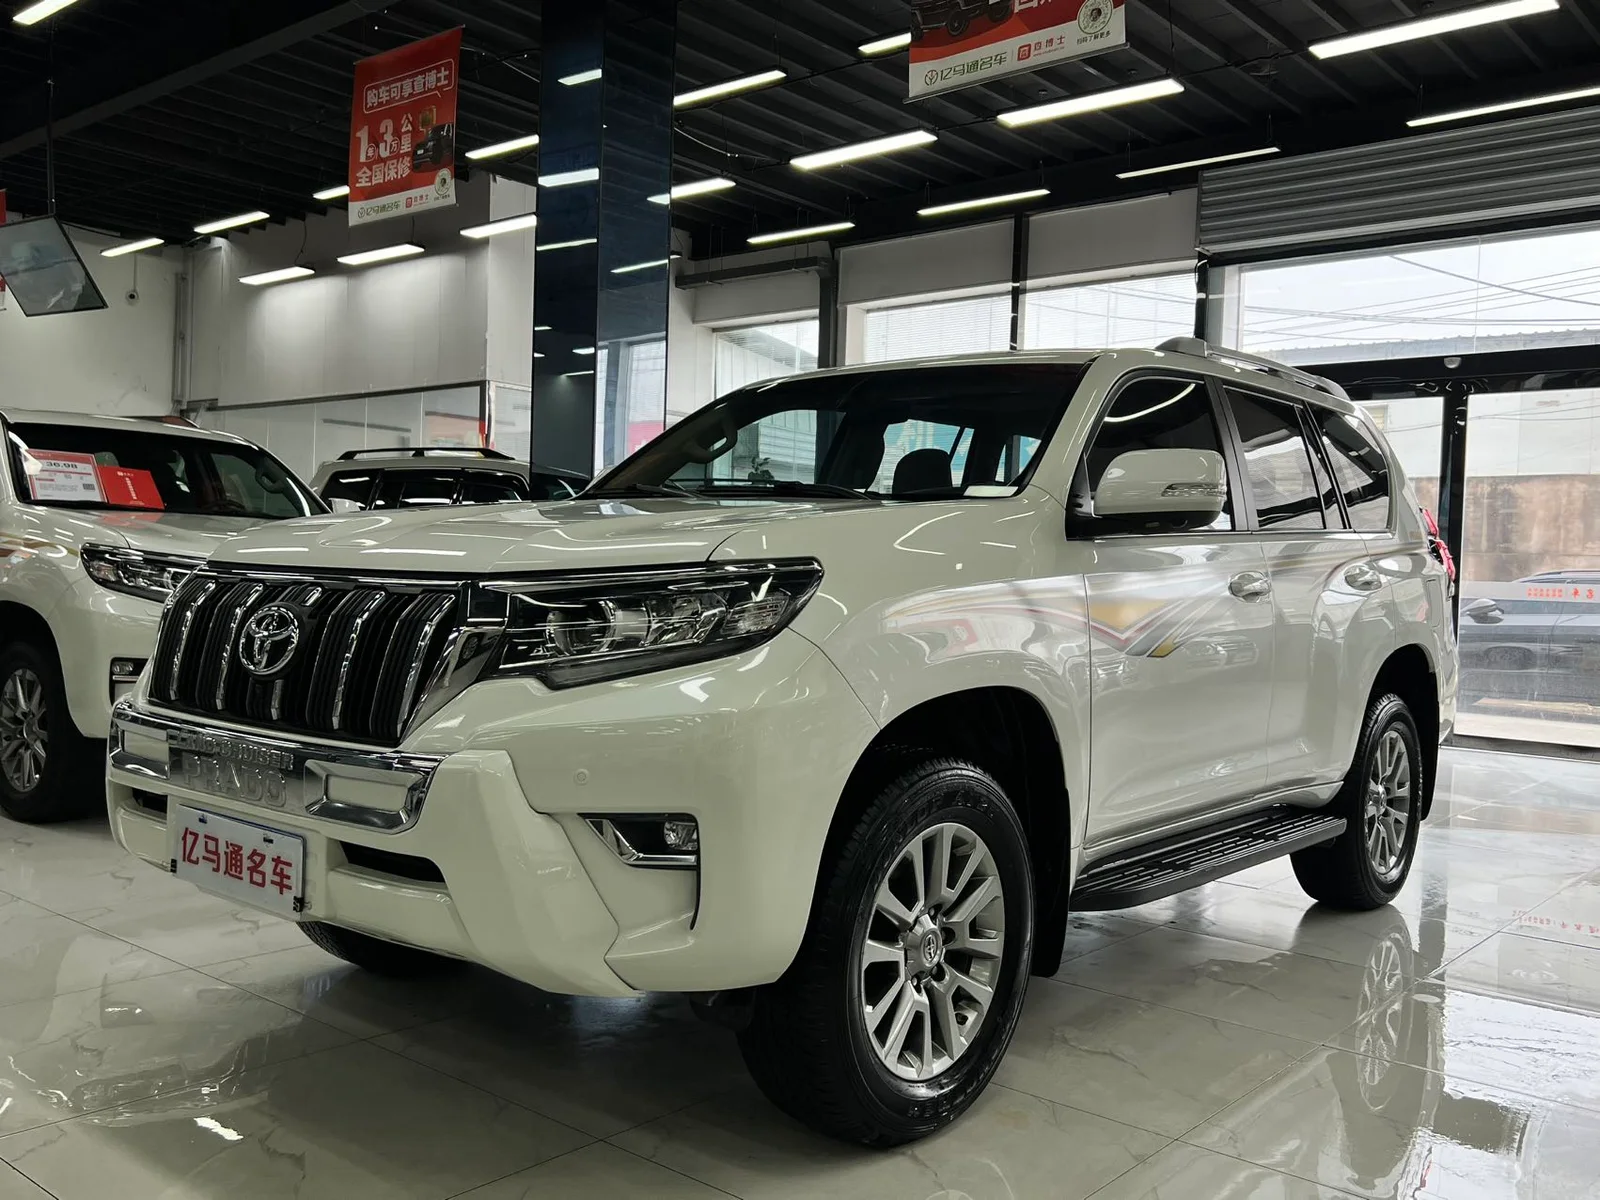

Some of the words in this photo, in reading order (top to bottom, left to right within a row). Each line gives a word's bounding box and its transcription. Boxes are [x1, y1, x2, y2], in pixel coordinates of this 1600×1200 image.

[940, 51, 1008, 82] 亿马通名车
[355, 157, 412, 188] 全国保修
[182, 751, 287, 808] PRADO
[181, 826, 293, 896] 亿马通名车
